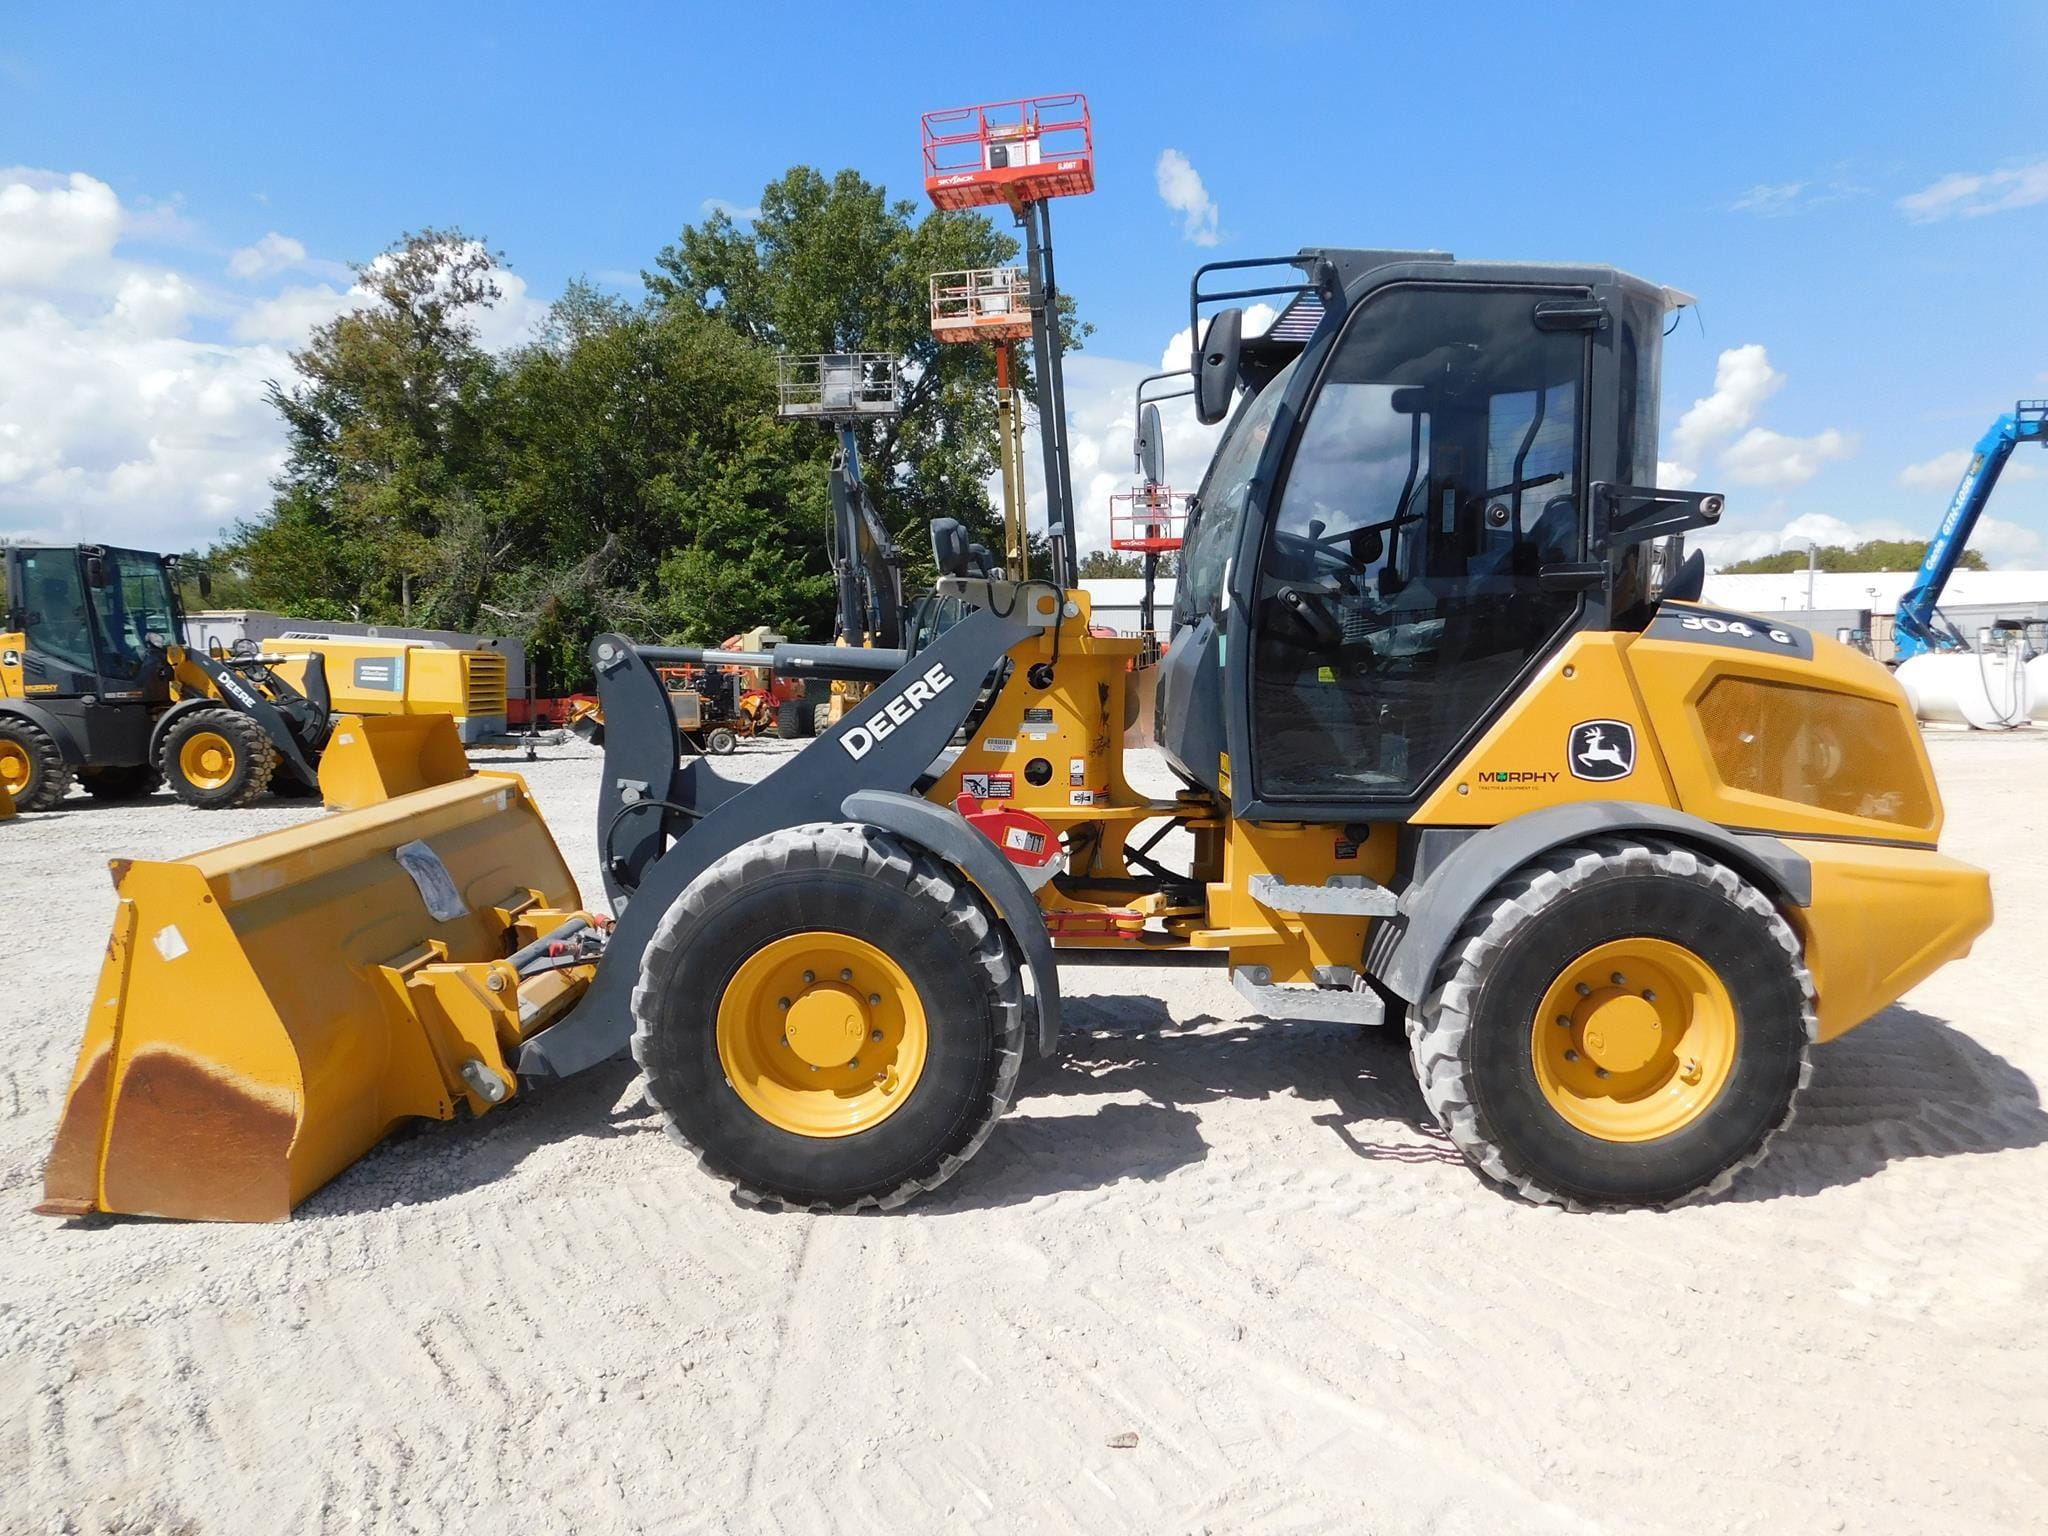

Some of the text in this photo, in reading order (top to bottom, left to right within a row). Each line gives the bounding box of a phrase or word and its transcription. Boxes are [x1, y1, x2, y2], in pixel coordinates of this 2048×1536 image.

[937, 174, 975, 186] SKYJACK
[1942, 475, 1974, 536] GTH-1056
[1925, 539, 1945, 571] Genie
[1677, 614, 1791, 644] 304 G
[217, 671, 256, 709] DEERE
[839, 662, 954, 761] DEERE
[1478, 771, 1560, 783] MURPHY
